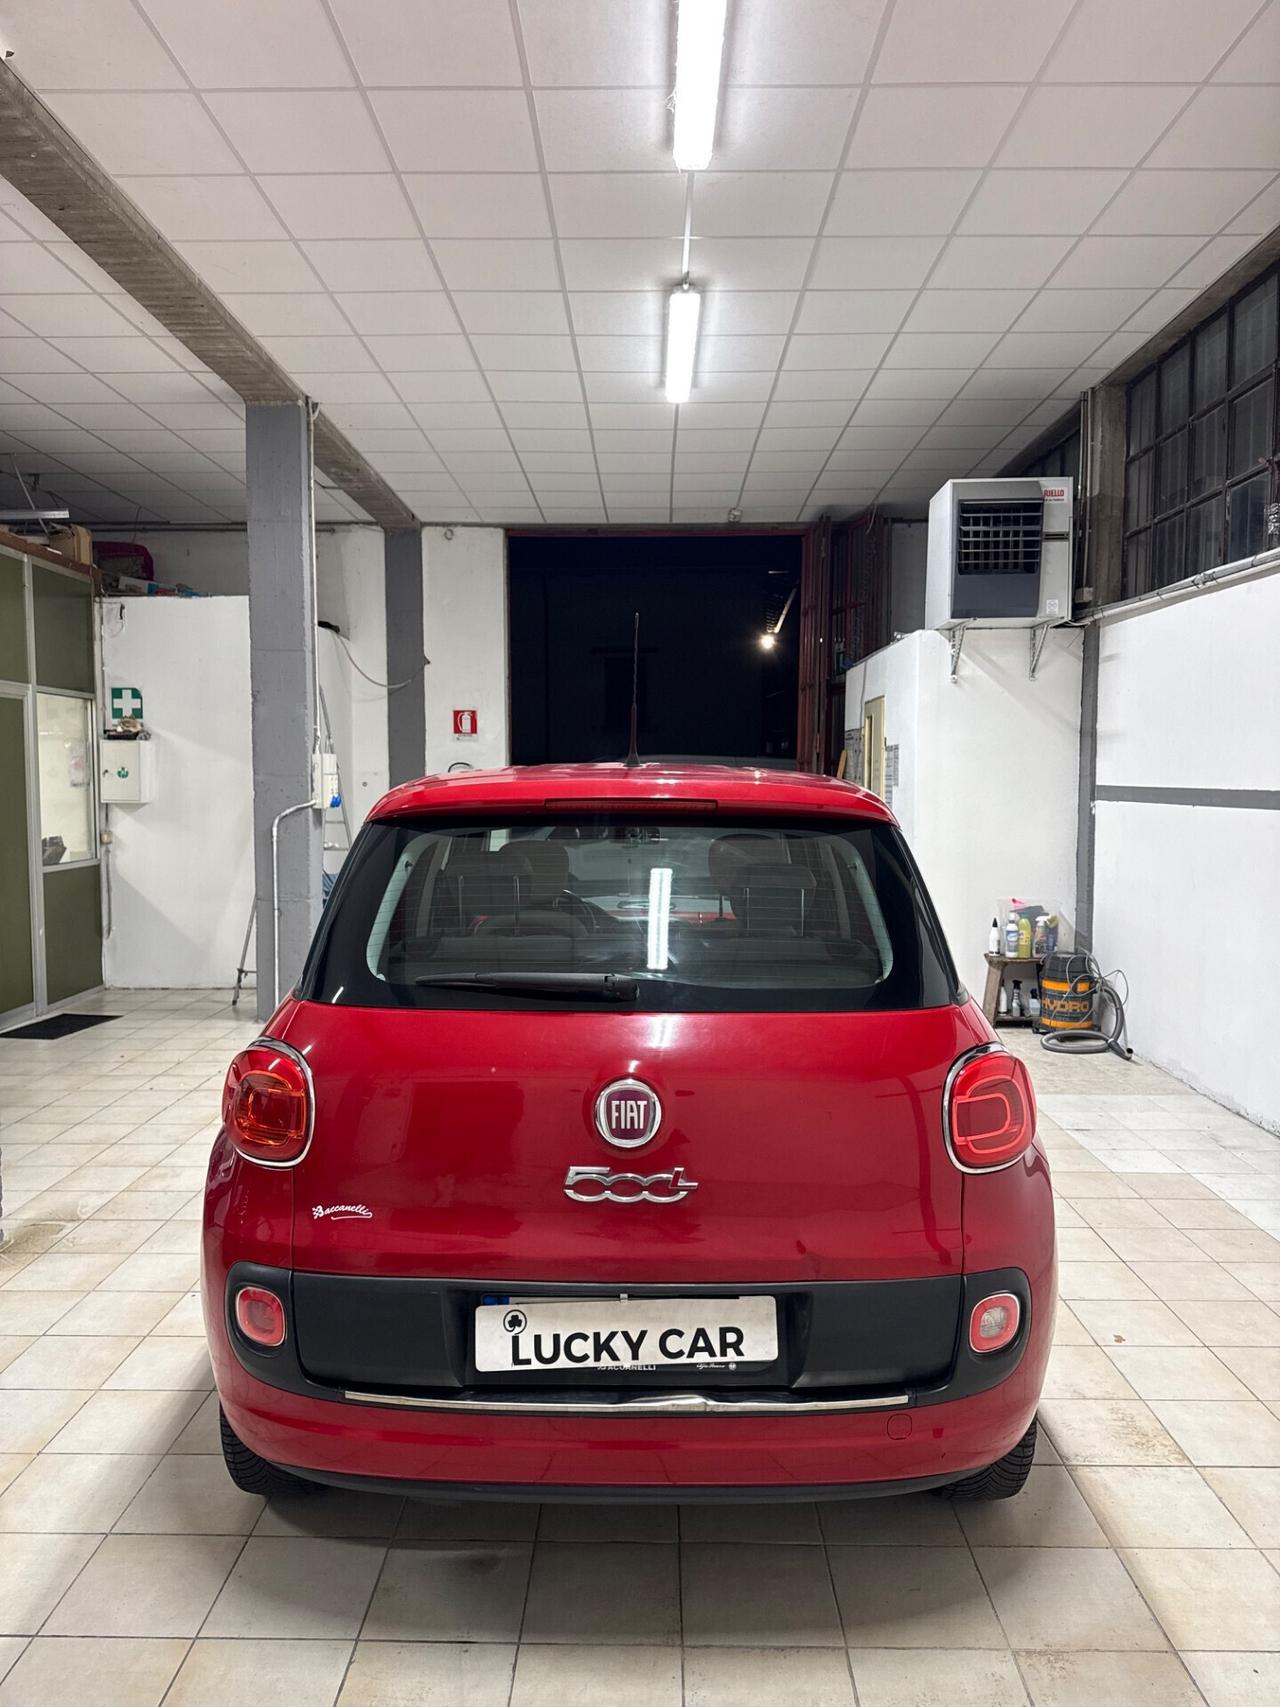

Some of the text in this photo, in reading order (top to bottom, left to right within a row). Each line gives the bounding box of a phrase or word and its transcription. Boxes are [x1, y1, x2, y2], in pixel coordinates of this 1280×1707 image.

[610, 1099, 648, 1130] FIAT
[563, 1165, 699, 1204] 500L
[312, 1204, 373, 1220] Baccanelli
[512, 1326, 745, 1366] LUCKY CAR
